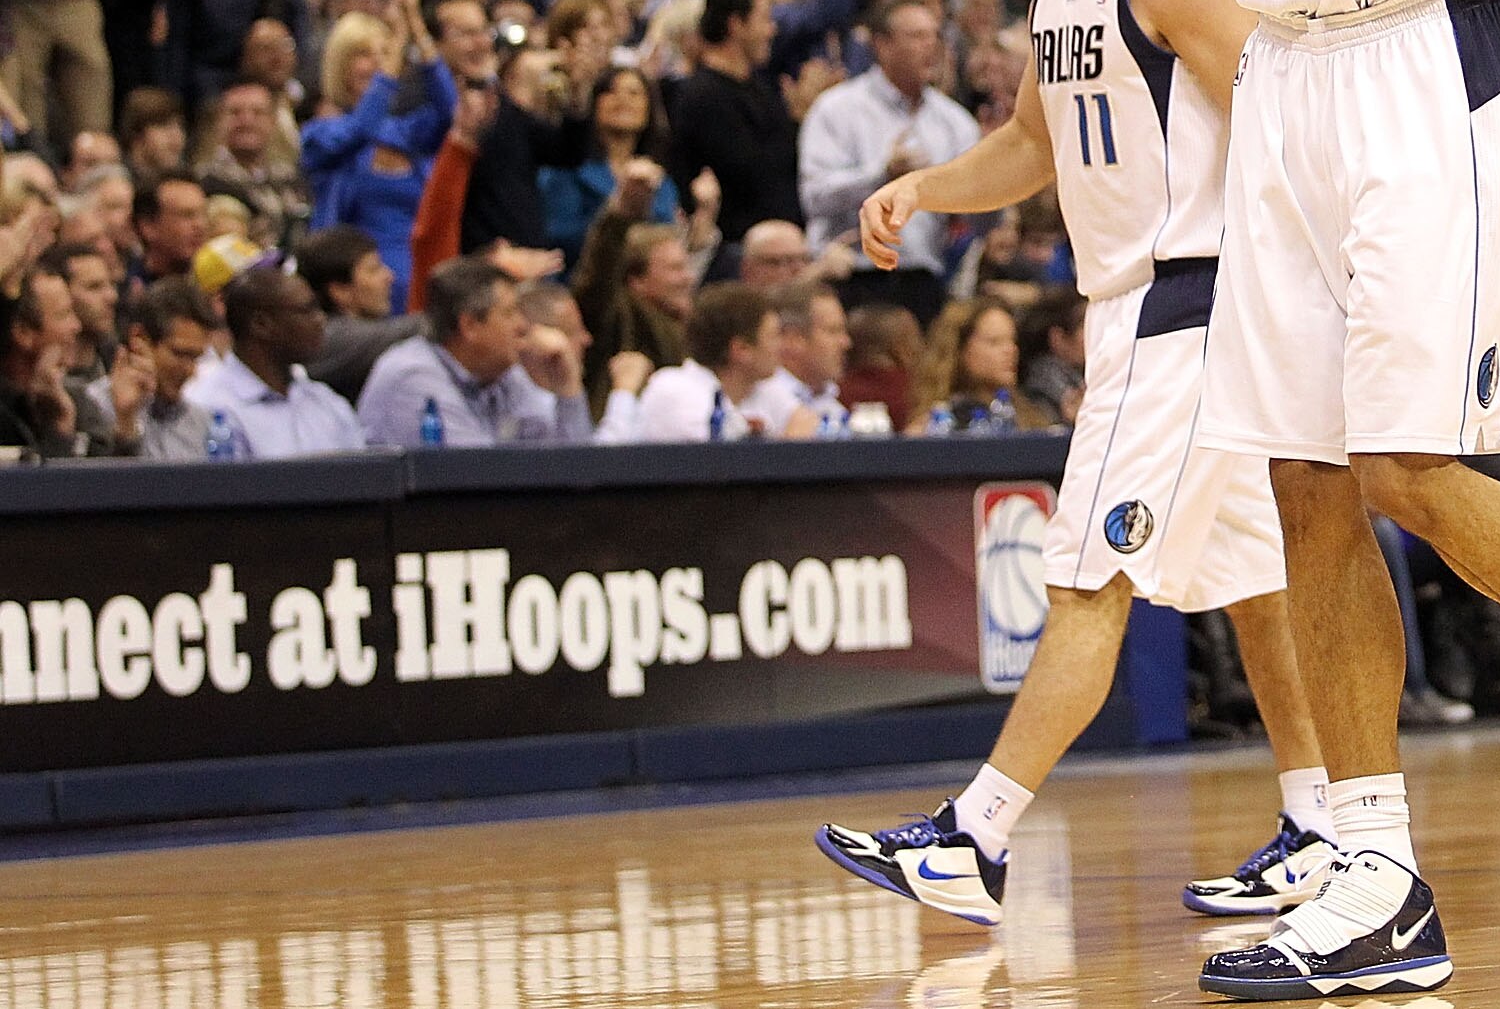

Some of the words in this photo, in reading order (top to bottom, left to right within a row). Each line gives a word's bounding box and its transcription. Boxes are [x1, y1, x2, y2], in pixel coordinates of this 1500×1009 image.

[1074, 93, 1118, 167] 11
[266, 557, 378, 691] at
[393, 547, 914, 698] iHoops.com
